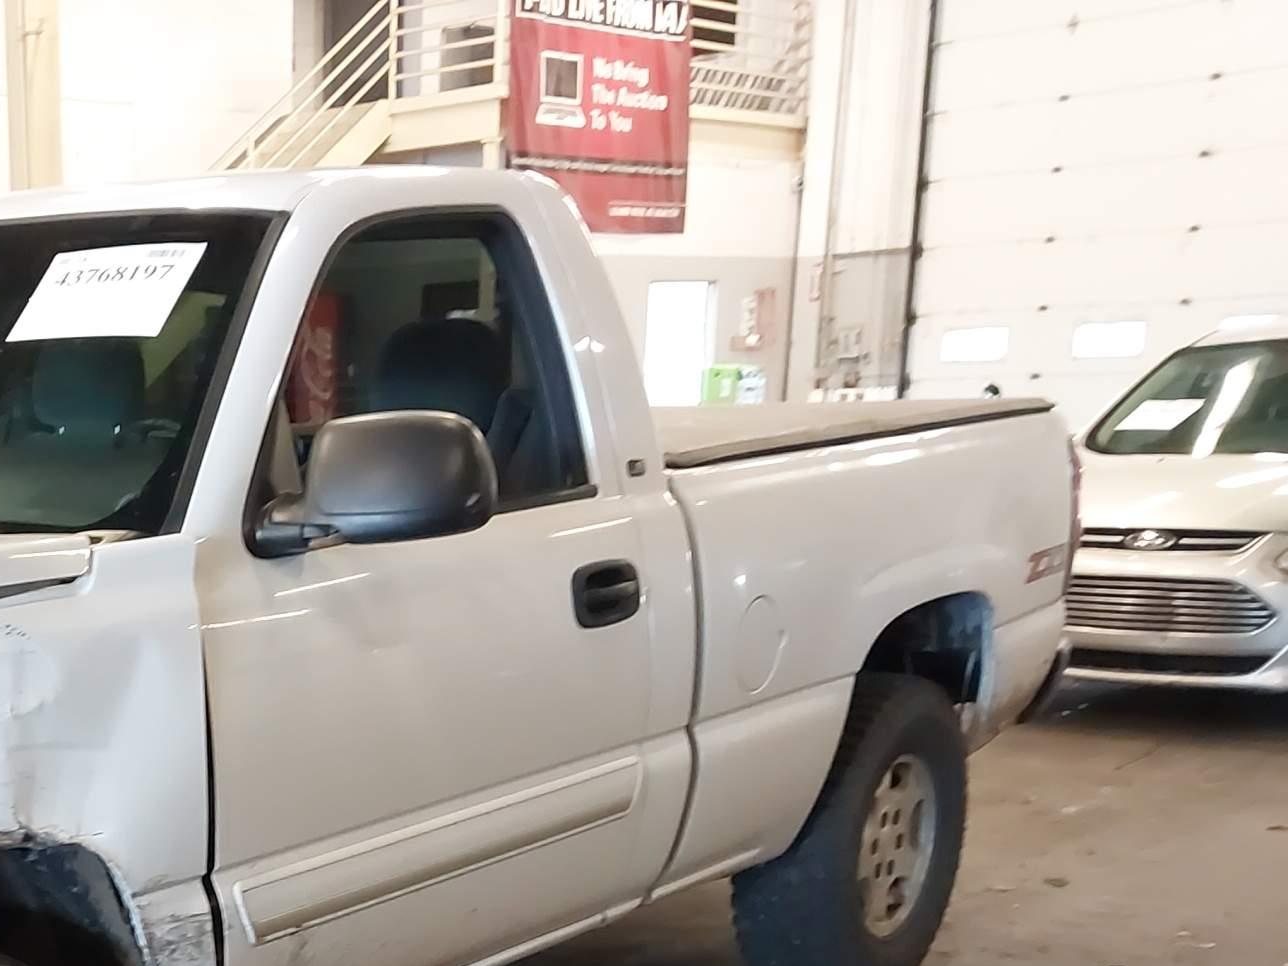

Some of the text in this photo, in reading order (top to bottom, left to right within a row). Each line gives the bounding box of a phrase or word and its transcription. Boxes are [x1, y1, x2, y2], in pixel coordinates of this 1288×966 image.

[592, 83, 668, 111] The Auction
[590, 108, 633, 132] To You
[54, 263, 176, 287] 43768197
